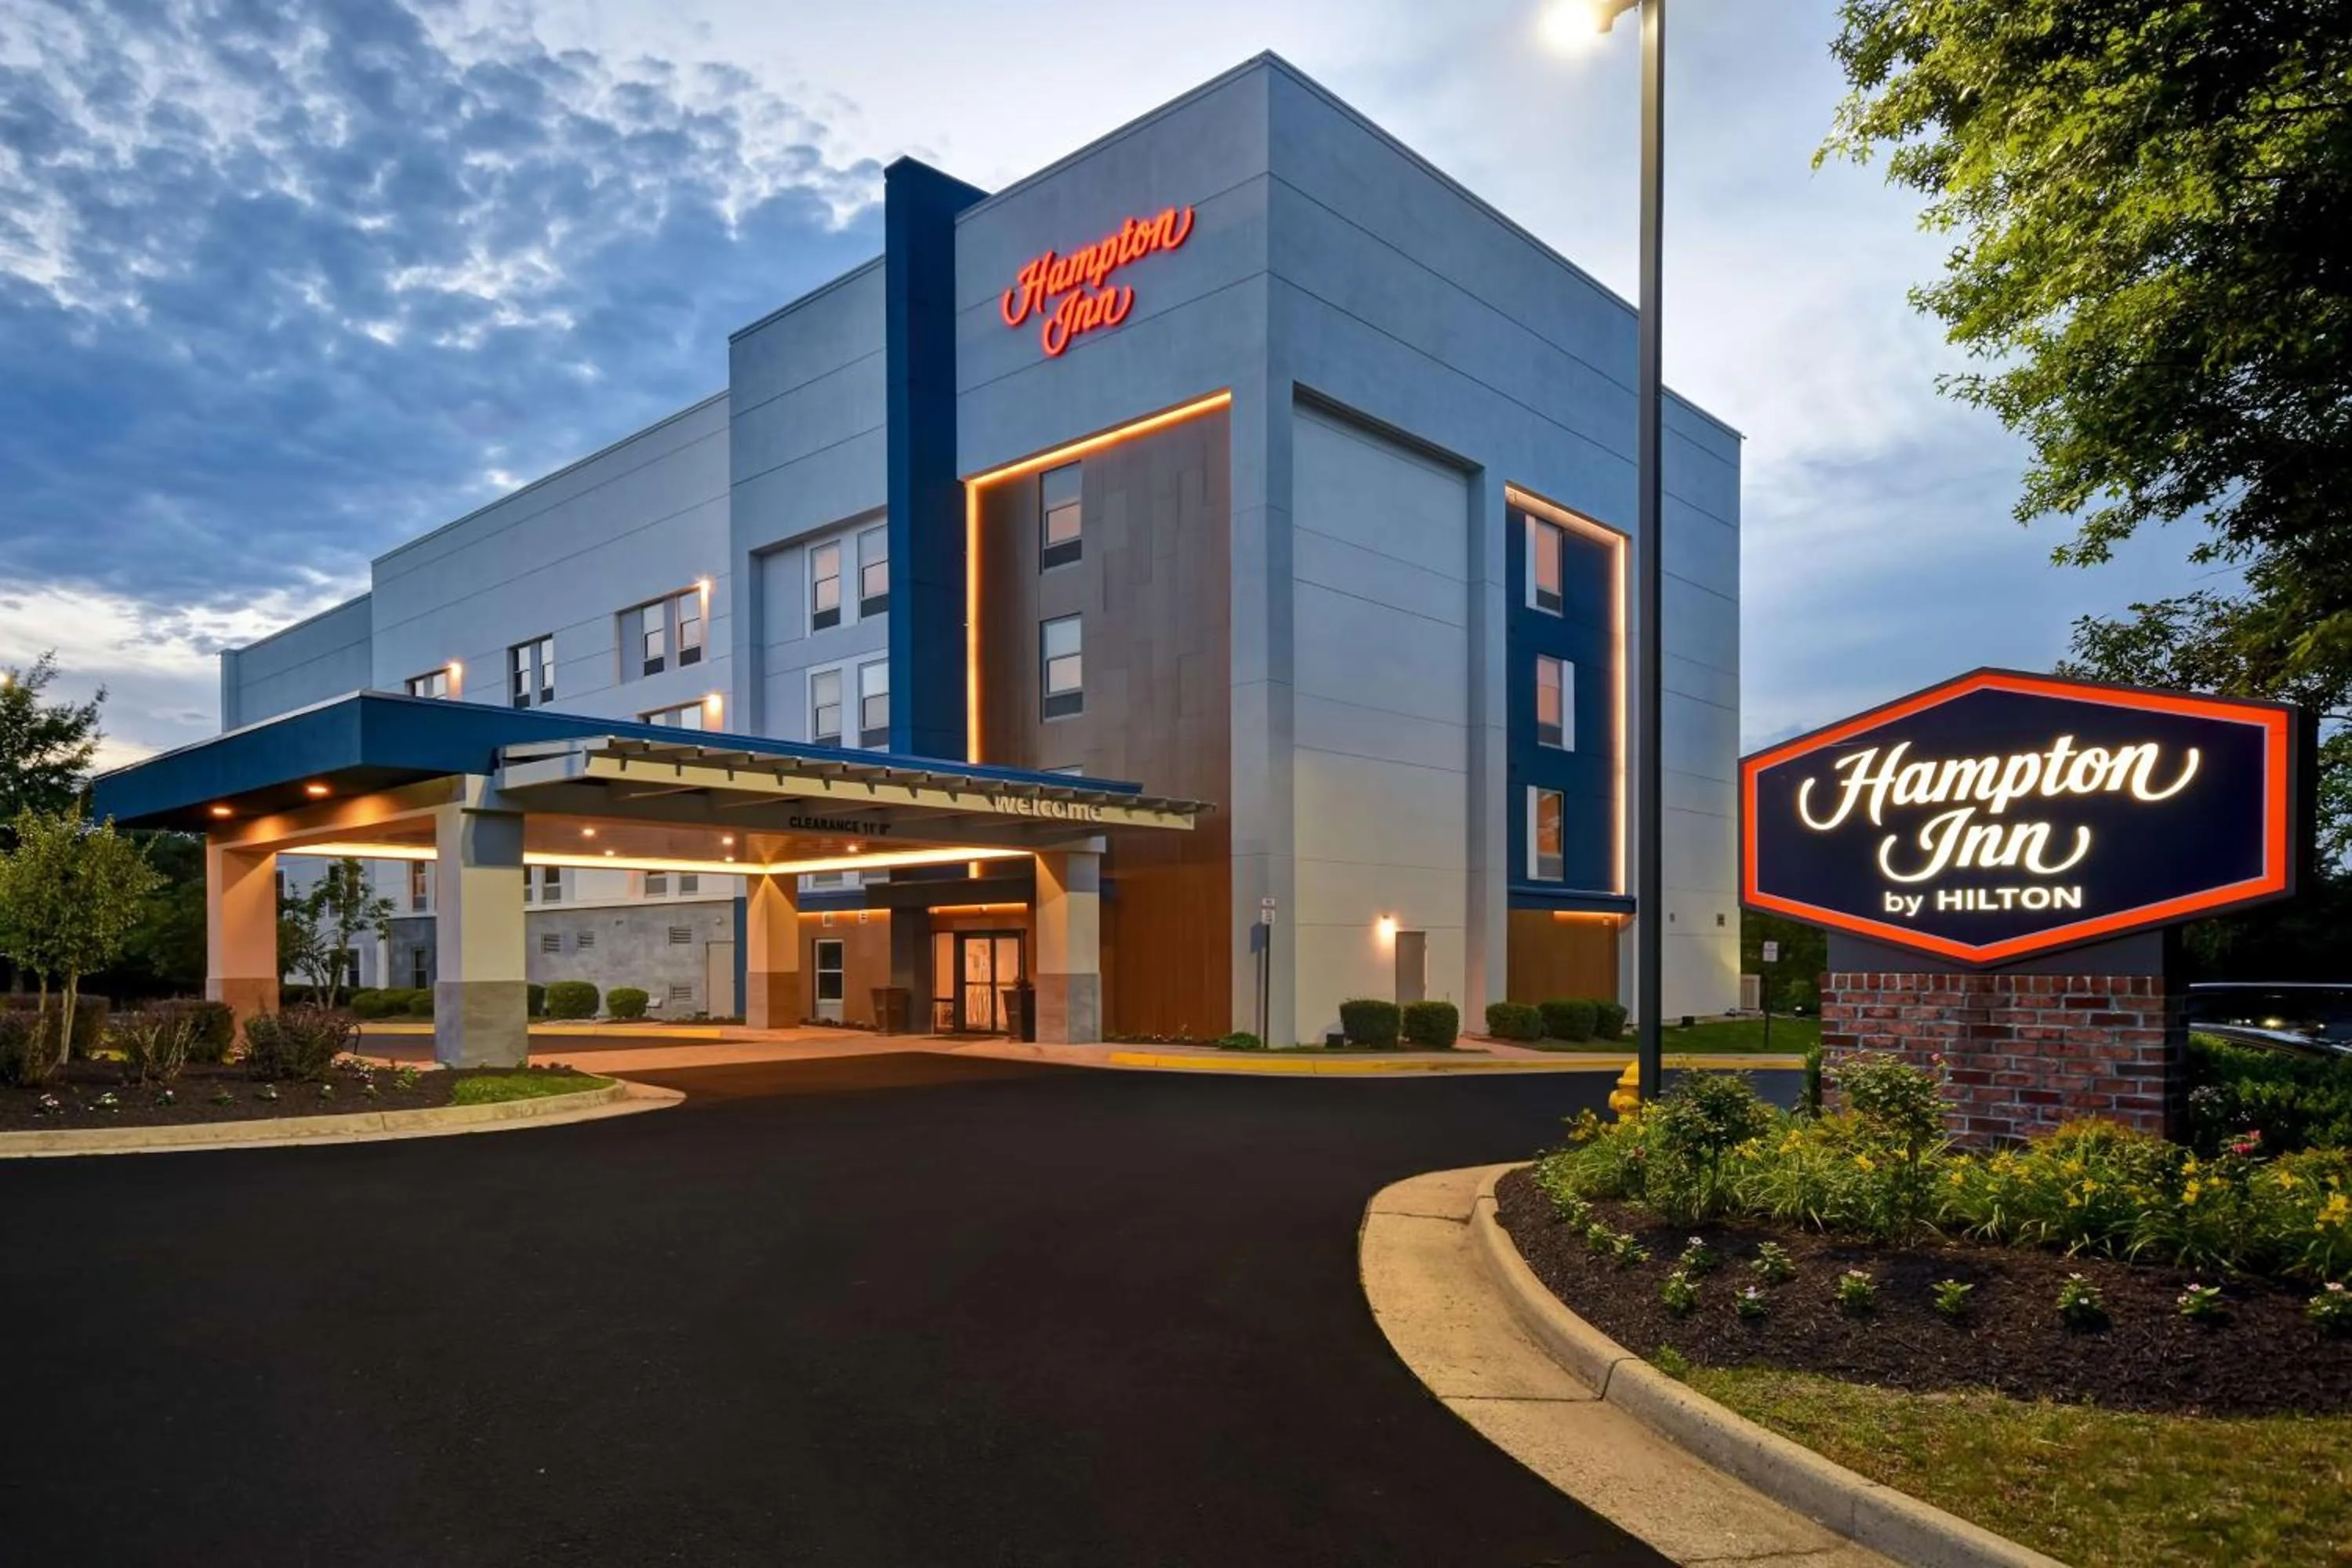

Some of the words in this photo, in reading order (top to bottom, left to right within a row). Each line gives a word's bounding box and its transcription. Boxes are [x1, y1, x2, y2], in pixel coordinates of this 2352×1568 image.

[1002, 206, 1195, 326] Hampton
[1042, 286, 1134, 357] Inn
[1799, 735, 2199, 831] Hampton
[789, 816, 860, 833] CLEARANCE
[1878, 808, 2090, 882] Inn
[1884, 891, 1923, 916] by
[1936, 886, 2082, 910] HILTON
